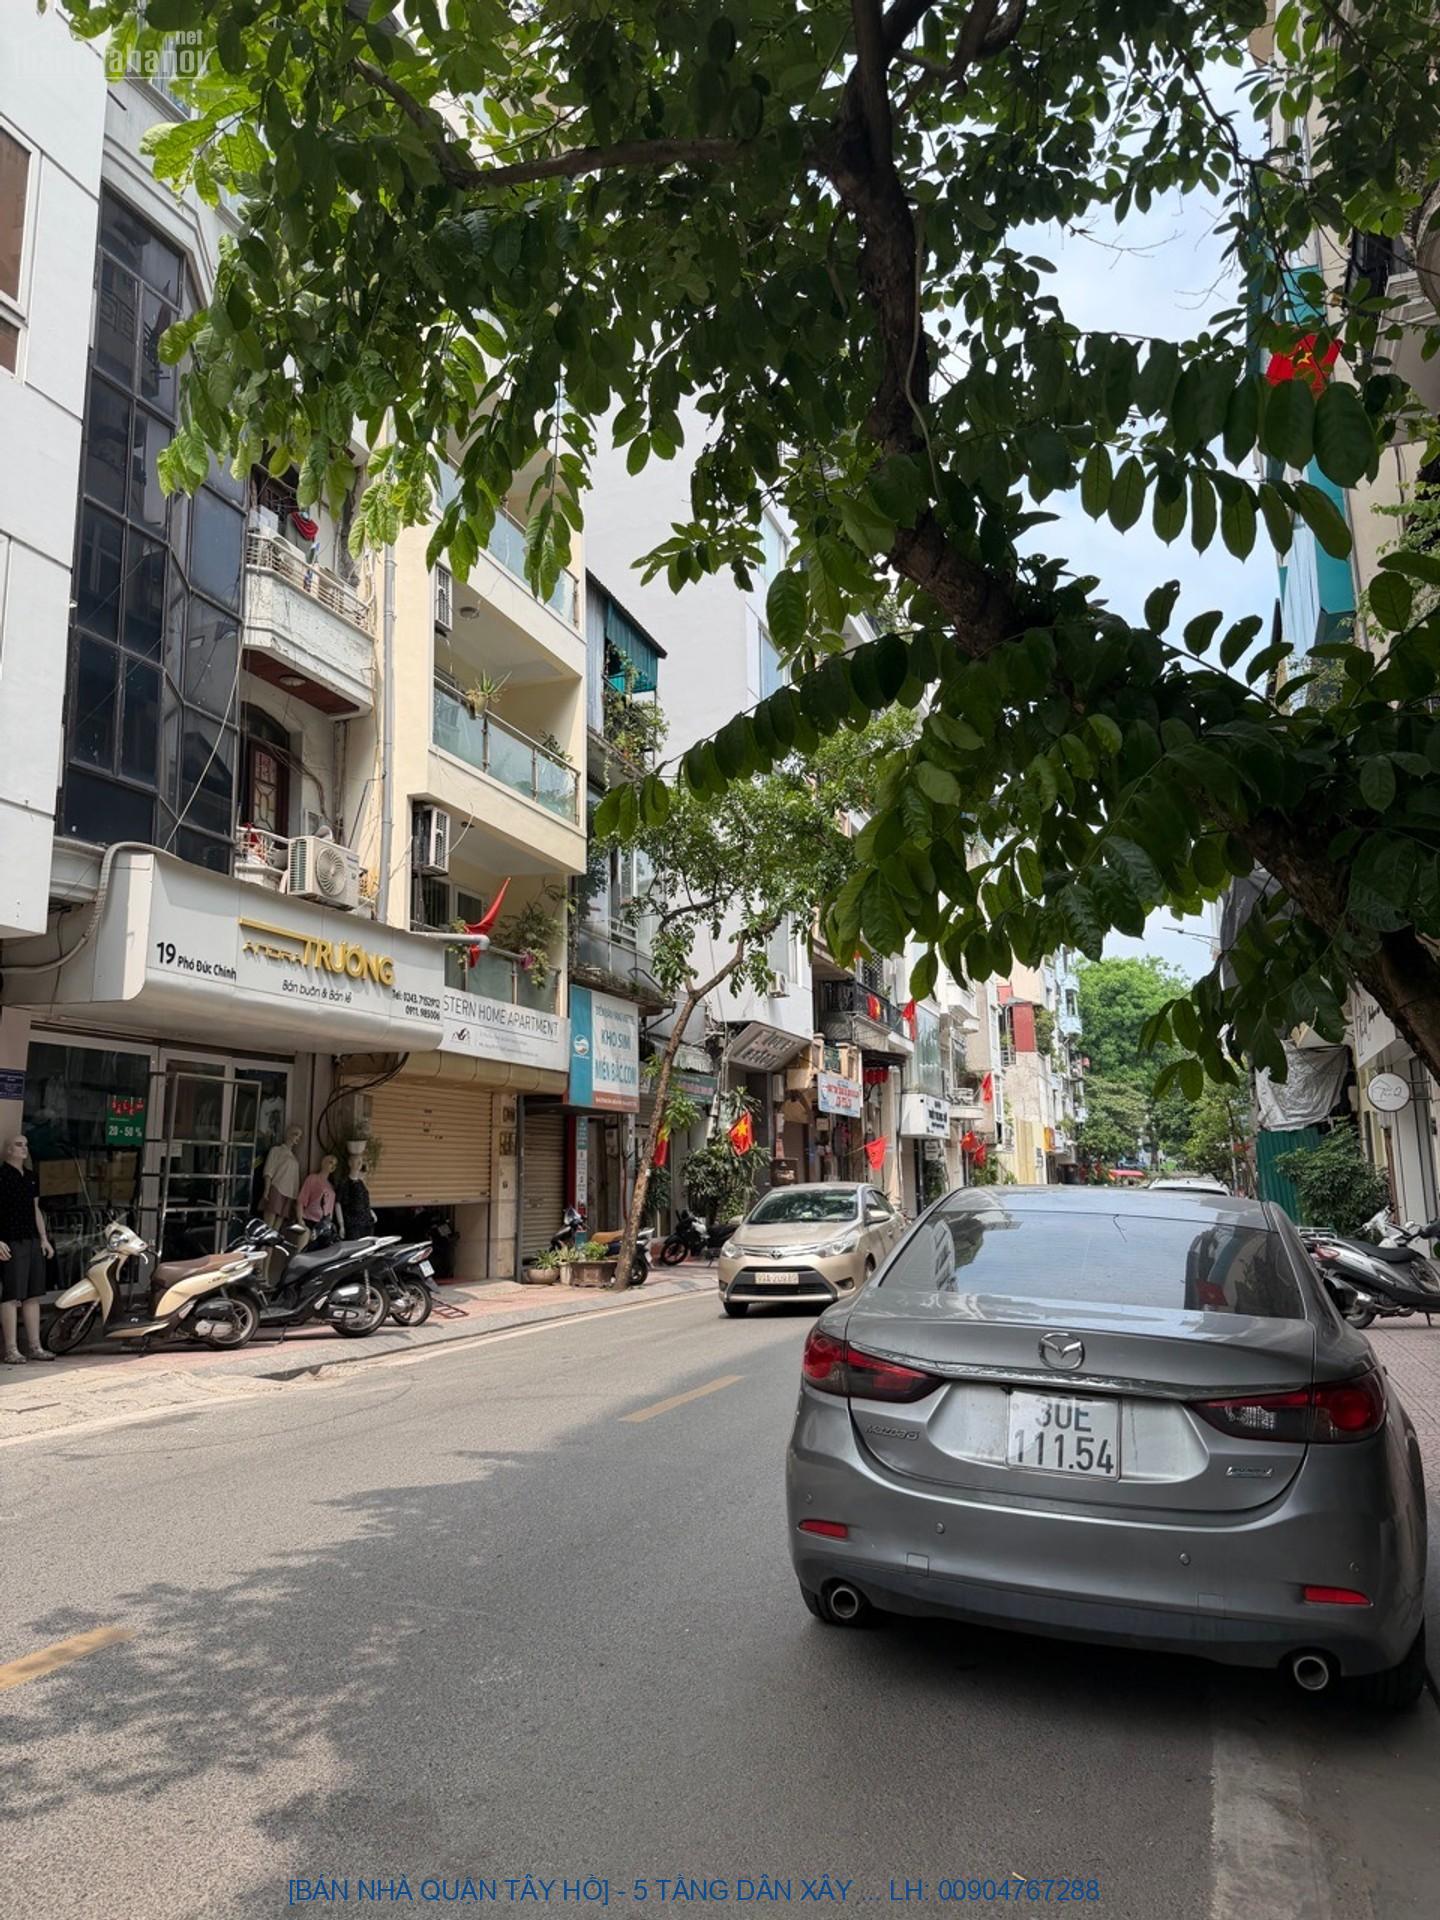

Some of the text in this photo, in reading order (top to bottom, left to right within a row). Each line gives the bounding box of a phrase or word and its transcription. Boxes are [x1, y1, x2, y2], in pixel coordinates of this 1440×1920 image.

[156, 941, 177, 964] 19
[478, 1003, 505, 1024] HOME
[507, 1010, 559, 1037] APARTMENT
[1014, 1429, 1114, 1474] 111.54
